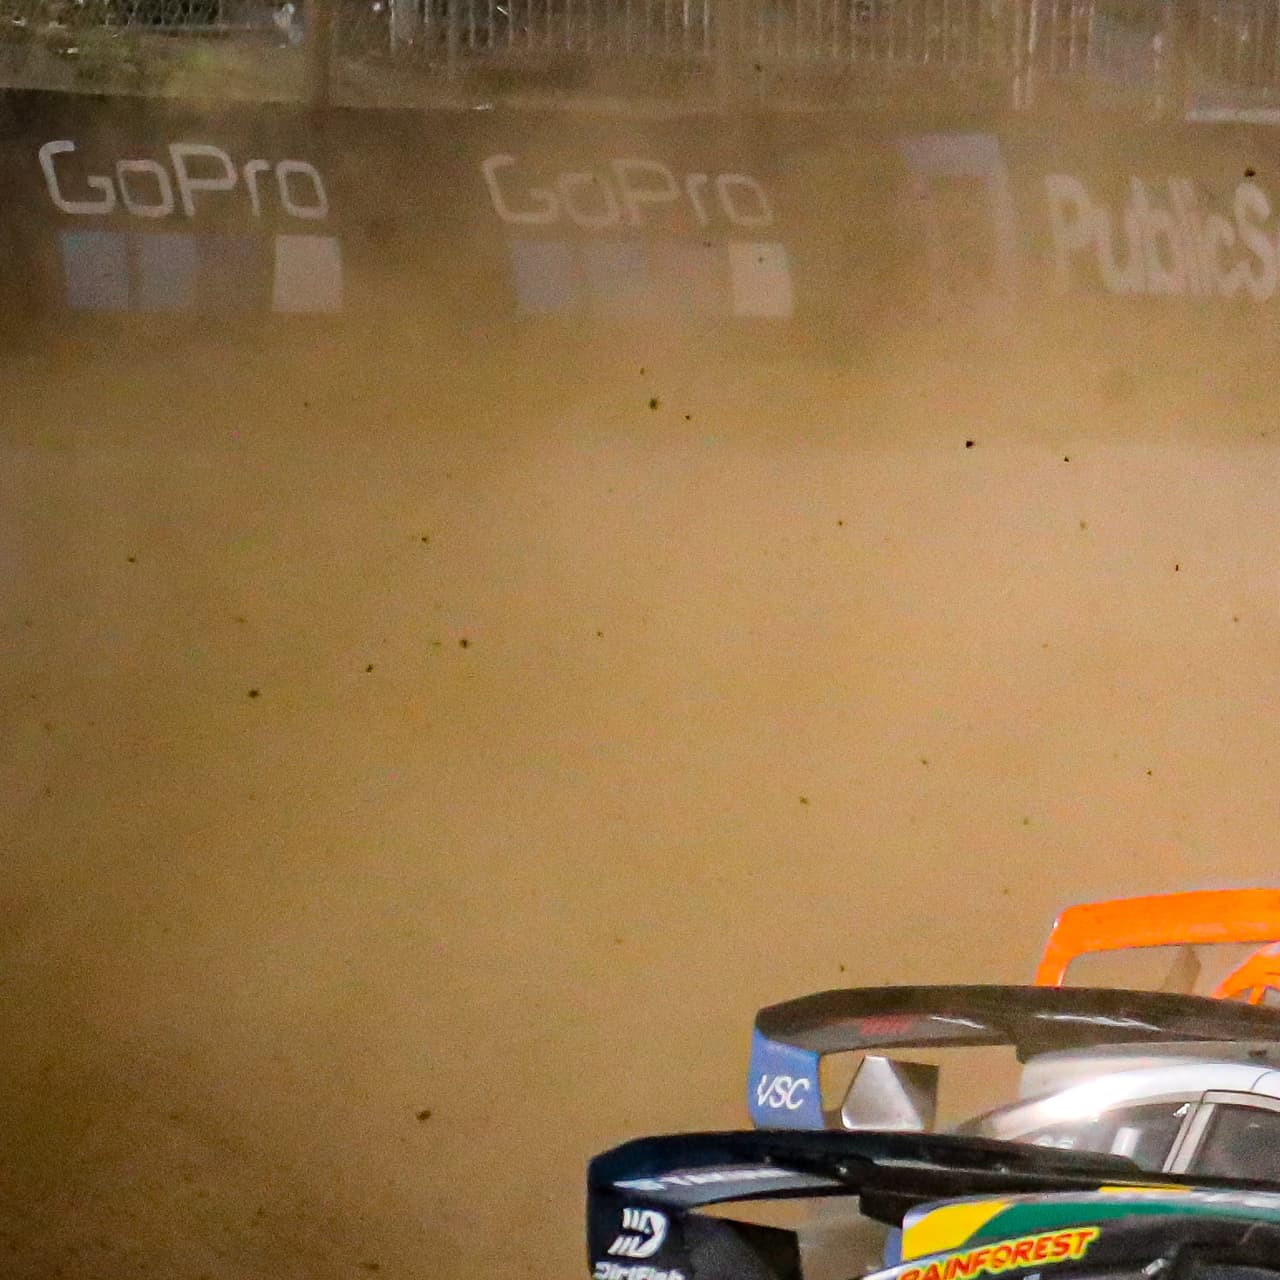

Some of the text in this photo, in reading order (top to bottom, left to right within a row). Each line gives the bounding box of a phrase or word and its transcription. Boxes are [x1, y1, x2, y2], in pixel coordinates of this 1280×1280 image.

[37, 139, 330, 219] GoPro
[480, 154, 775, 229] GoPro
[756, 1073, 810, 1111] VSC
